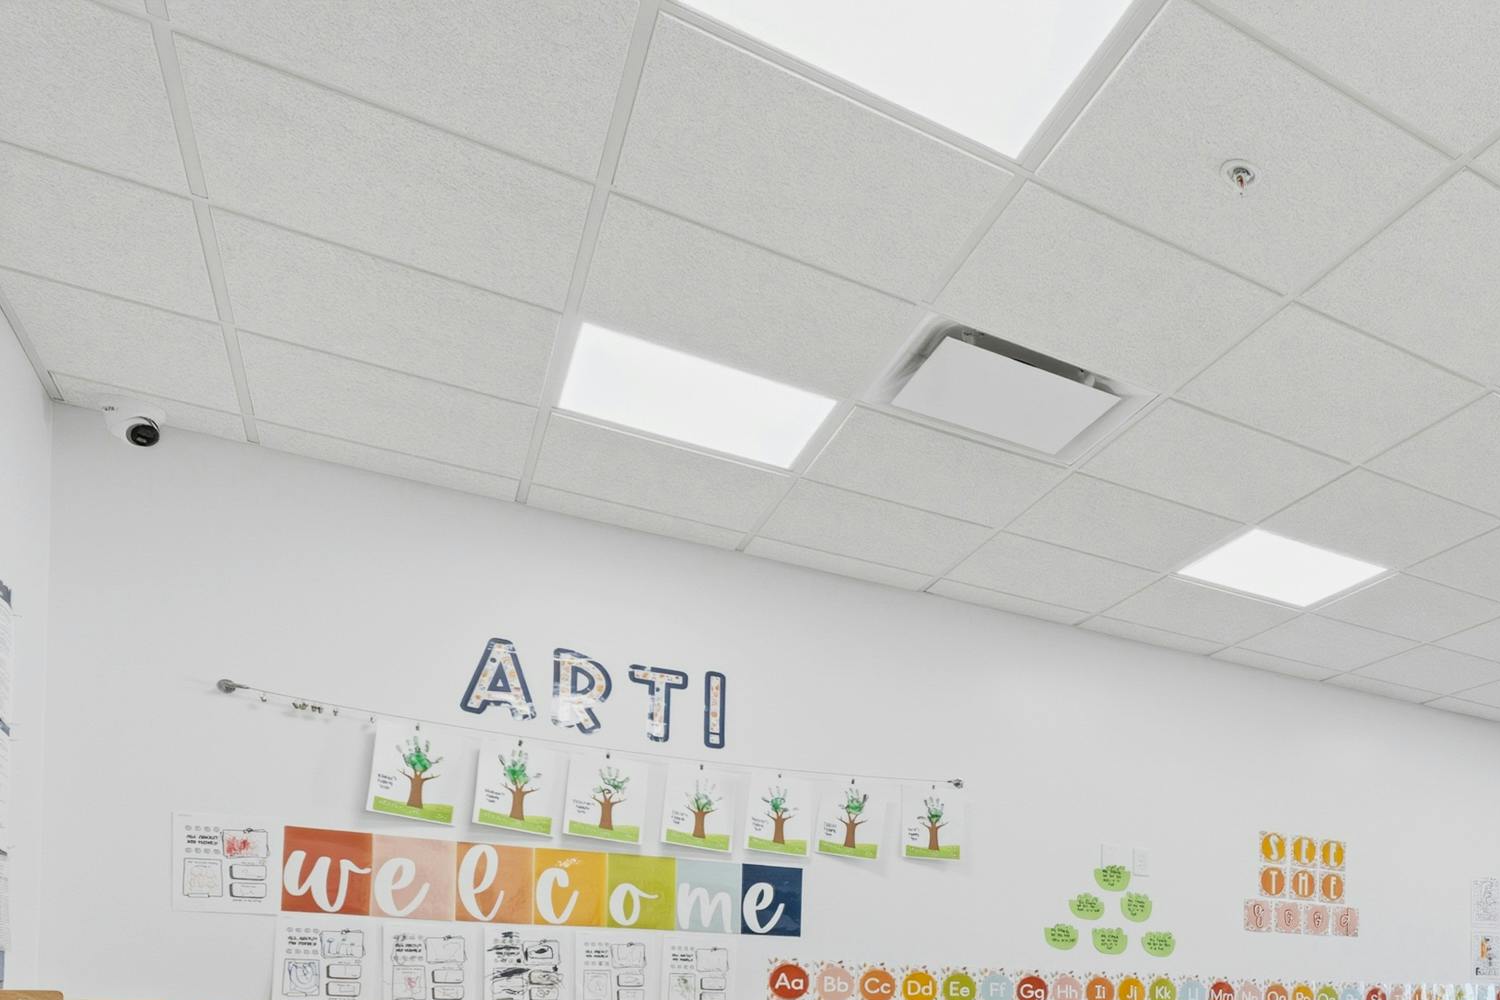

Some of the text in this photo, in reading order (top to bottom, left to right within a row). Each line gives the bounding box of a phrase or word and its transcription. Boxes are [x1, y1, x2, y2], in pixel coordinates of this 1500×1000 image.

[282, 843, 786, 935] welcome
[1269, 870, 1338, 899] THE
[774, 972, 805, 991] Aa
[823, 976, 849, 993] Bb
[864, 978, 892, 995] Cc
[906, 979, 933, 996] Dd
[949, 981, 971, 997] Ee
[989, 982, 1007, 998] Ff
[1057, 986, 1079, 999] Hh
[1095, 985, 1106, 999] Ii
[1155, 986, 1171, 1000] Kk
